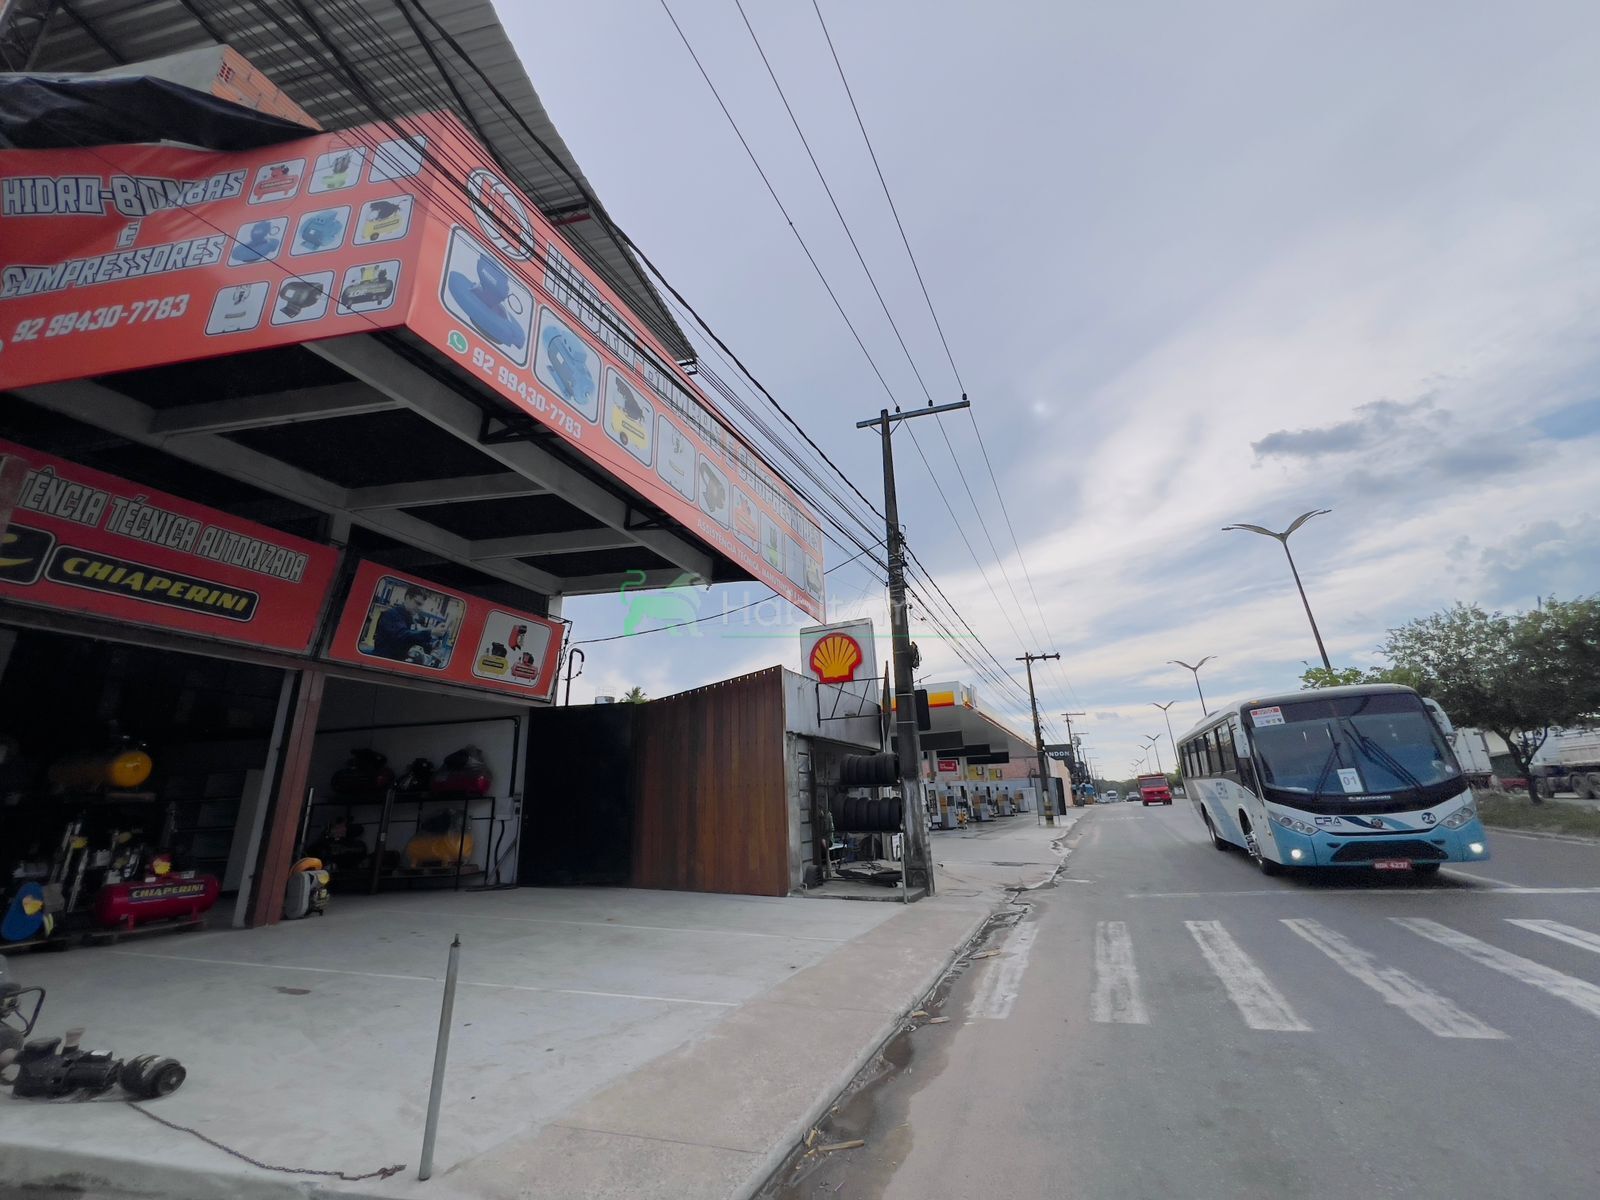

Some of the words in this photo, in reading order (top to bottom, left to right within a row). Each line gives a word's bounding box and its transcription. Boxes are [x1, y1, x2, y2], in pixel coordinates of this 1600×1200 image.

[116, 219, 142, 248] E
[1, 235, 227, 299] COMPRESSORES
[12, 317, 45, 342] 92
[45, 294, 190, 337] 99430-7783
[472, 347, 495, 375] 92
[497, 365, 582, 439] 99430-7783
[104, 494, 203, 554] TÉCNICA
[195, 524, 309, 584] AUTORIZADA
[62, 556, 250, 612] CHIAPERINI
[1343, 776, 1357, 785] 01
[132, 884, 205, 898] CHIAPERINI
